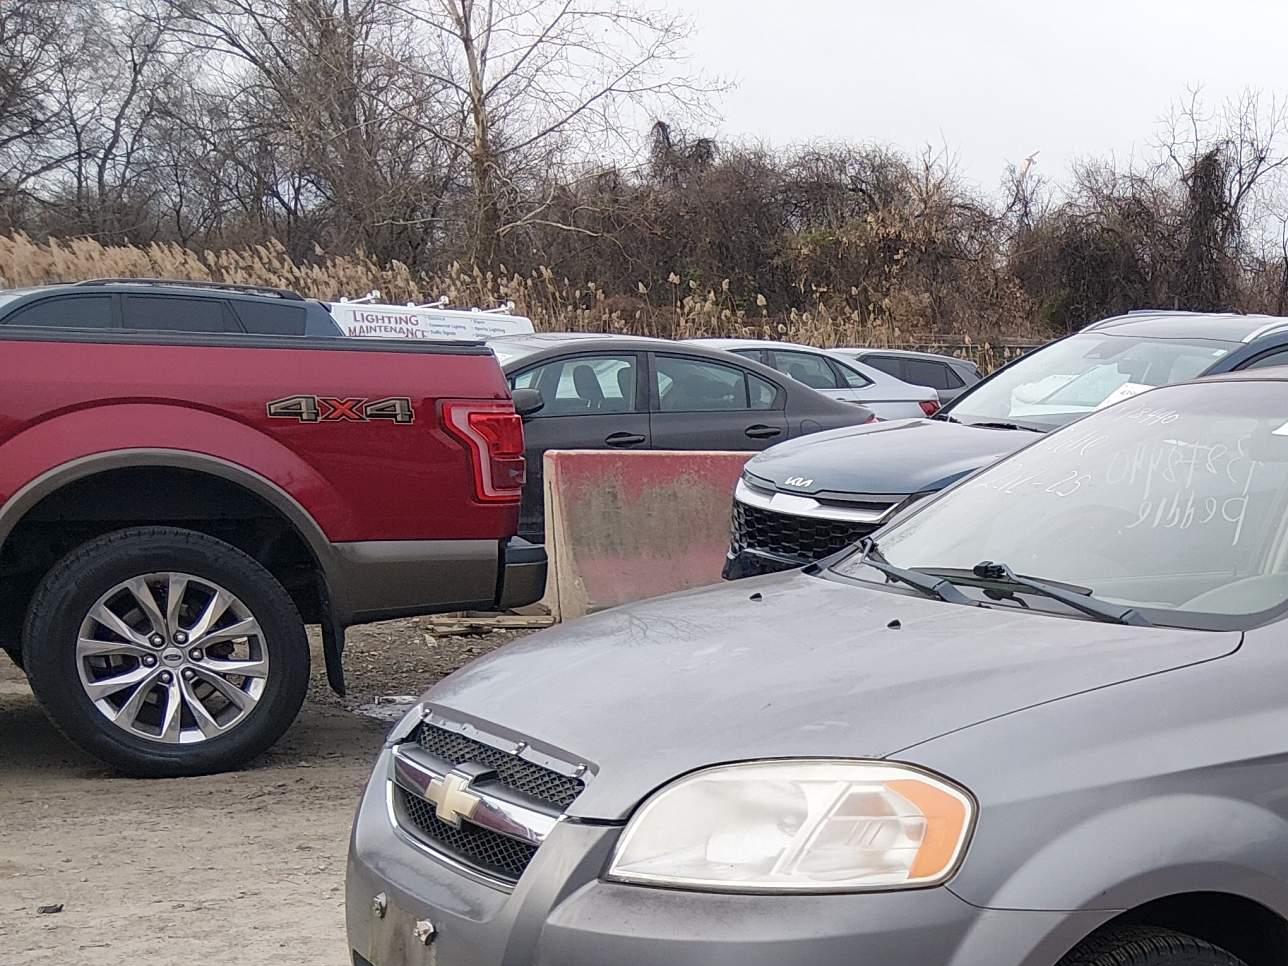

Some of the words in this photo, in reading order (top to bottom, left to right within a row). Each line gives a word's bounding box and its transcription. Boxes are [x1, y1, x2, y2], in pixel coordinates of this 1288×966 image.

[352, 310, 419, 326] LIGHTING
[348, 325, 426, 339] MAINTENANCE
[784, 476, 814, 487] KIA
